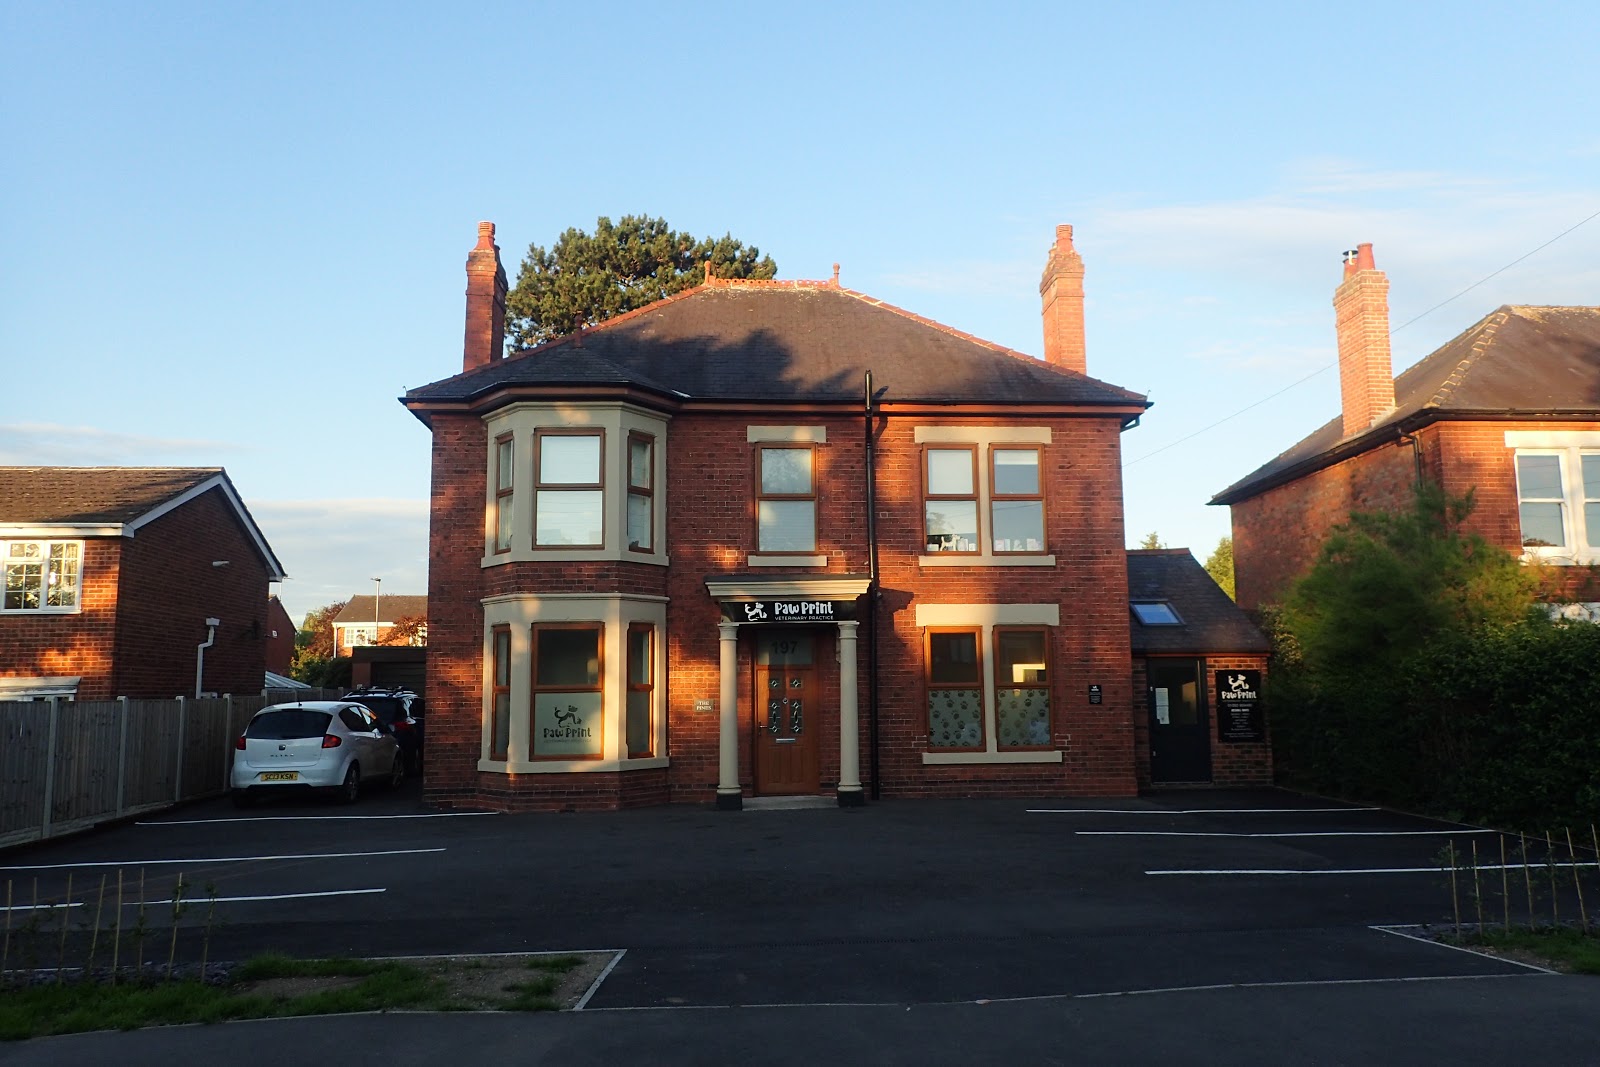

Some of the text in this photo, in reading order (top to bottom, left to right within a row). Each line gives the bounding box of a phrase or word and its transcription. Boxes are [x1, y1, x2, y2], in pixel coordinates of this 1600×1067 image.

[774, 602, 833, 615] Paw Print
[772, 641, 798, 654] 197
[1221, 691, 1256, 699] Paw Print
[544, 727, 591, 738] Paw Print
